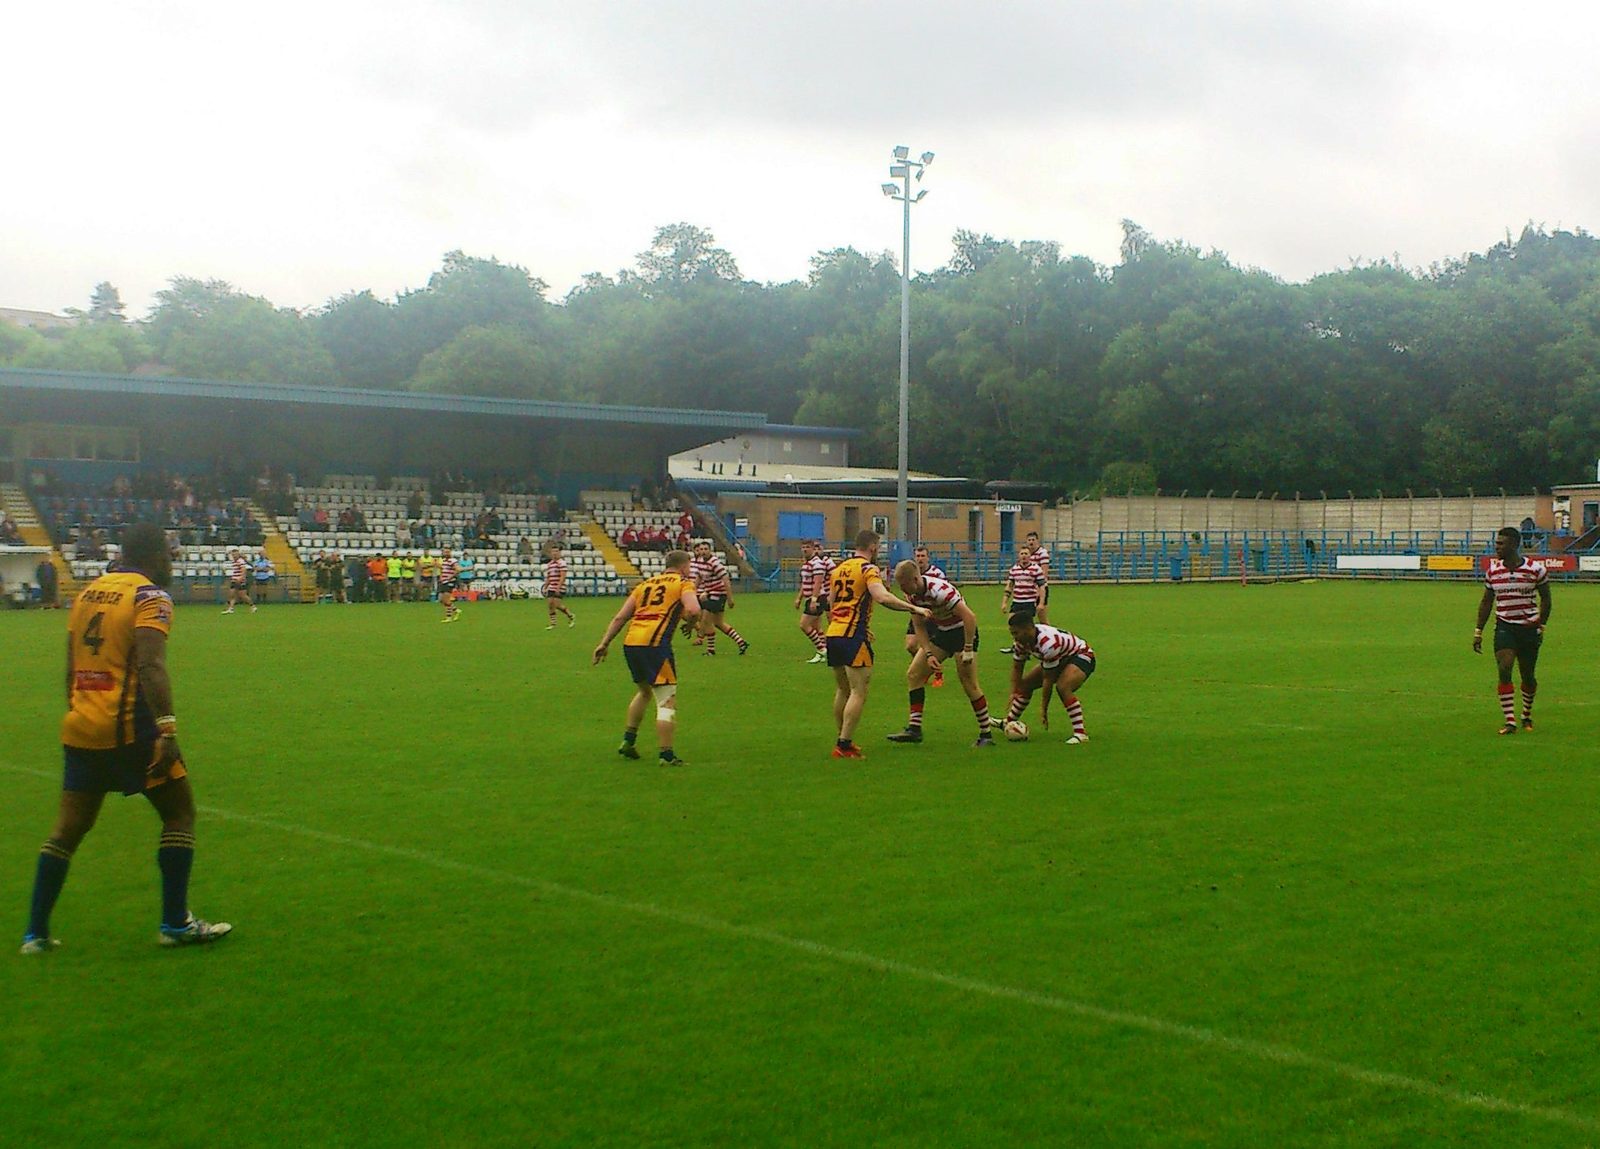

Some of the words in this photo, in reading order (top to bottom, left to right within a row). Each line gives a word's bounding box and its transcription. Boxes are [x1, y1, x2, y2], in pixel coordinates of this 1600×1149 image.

[641, 585, 666, 607] 13
[834, 579, 855, 602] 25
[83, 611, 105, 656] 4
